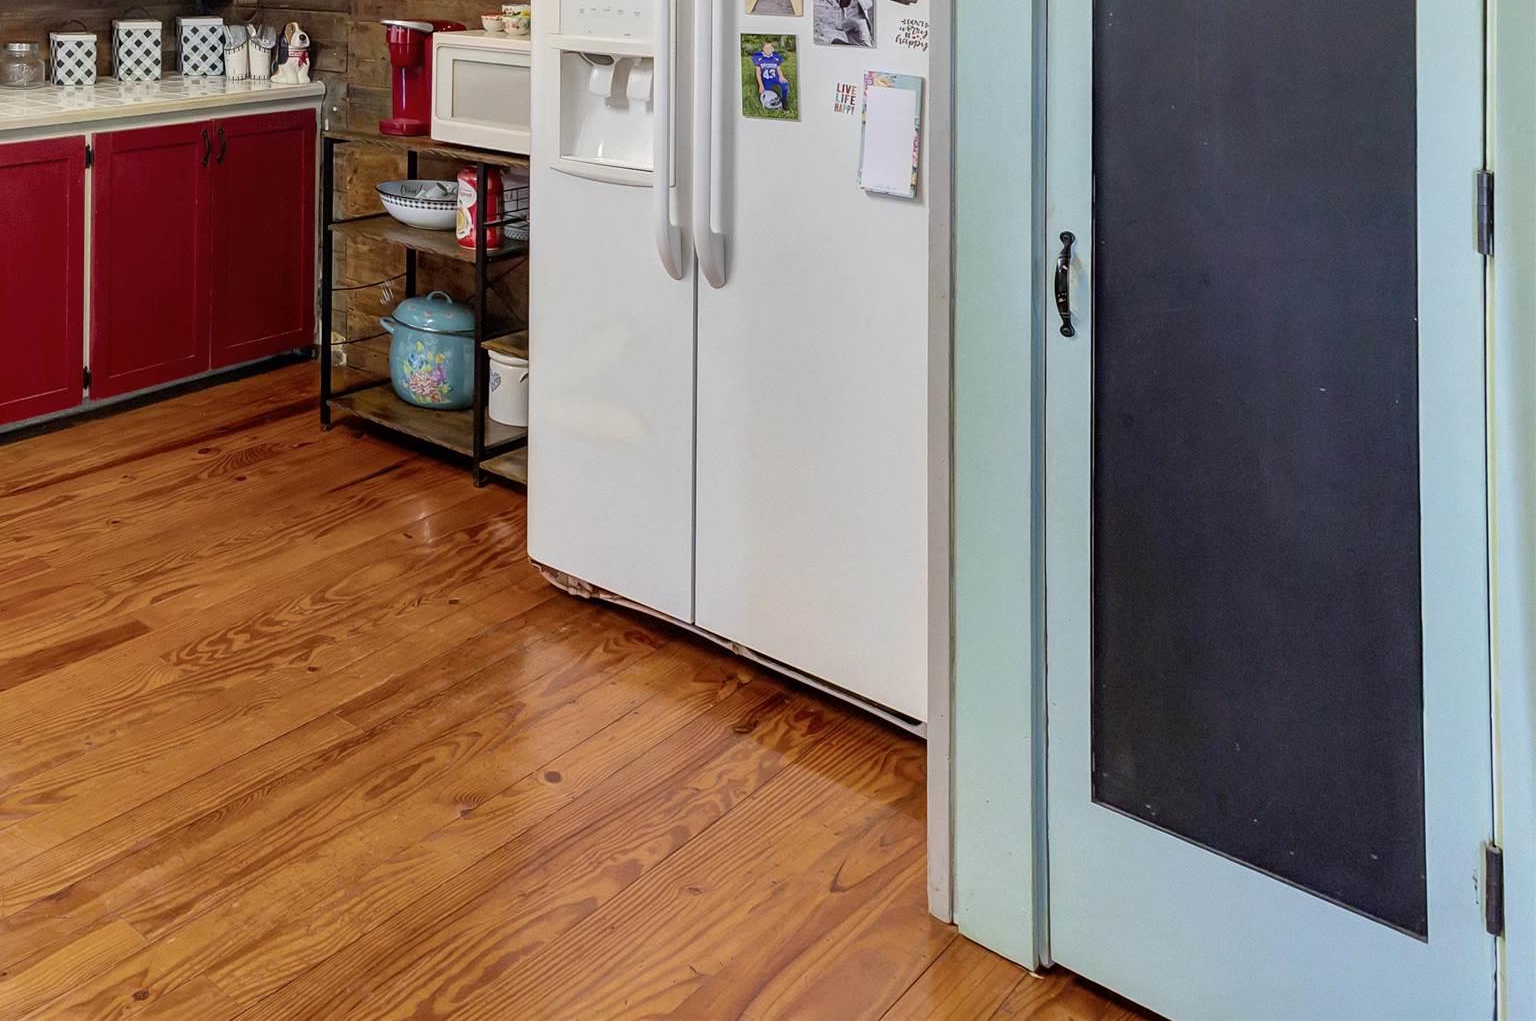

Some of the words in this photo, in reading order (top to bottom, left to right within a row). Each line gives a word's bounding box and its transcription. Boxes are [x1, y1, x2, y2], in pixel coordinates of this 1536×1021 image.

[895, 34, 928, 51] happy
[763, 69, 776, 80] 43
[837, 82, 856, 94] LIVE
[836, 93, 856, 105] LIFE
[834, 103, 855, 114] HAPPY
